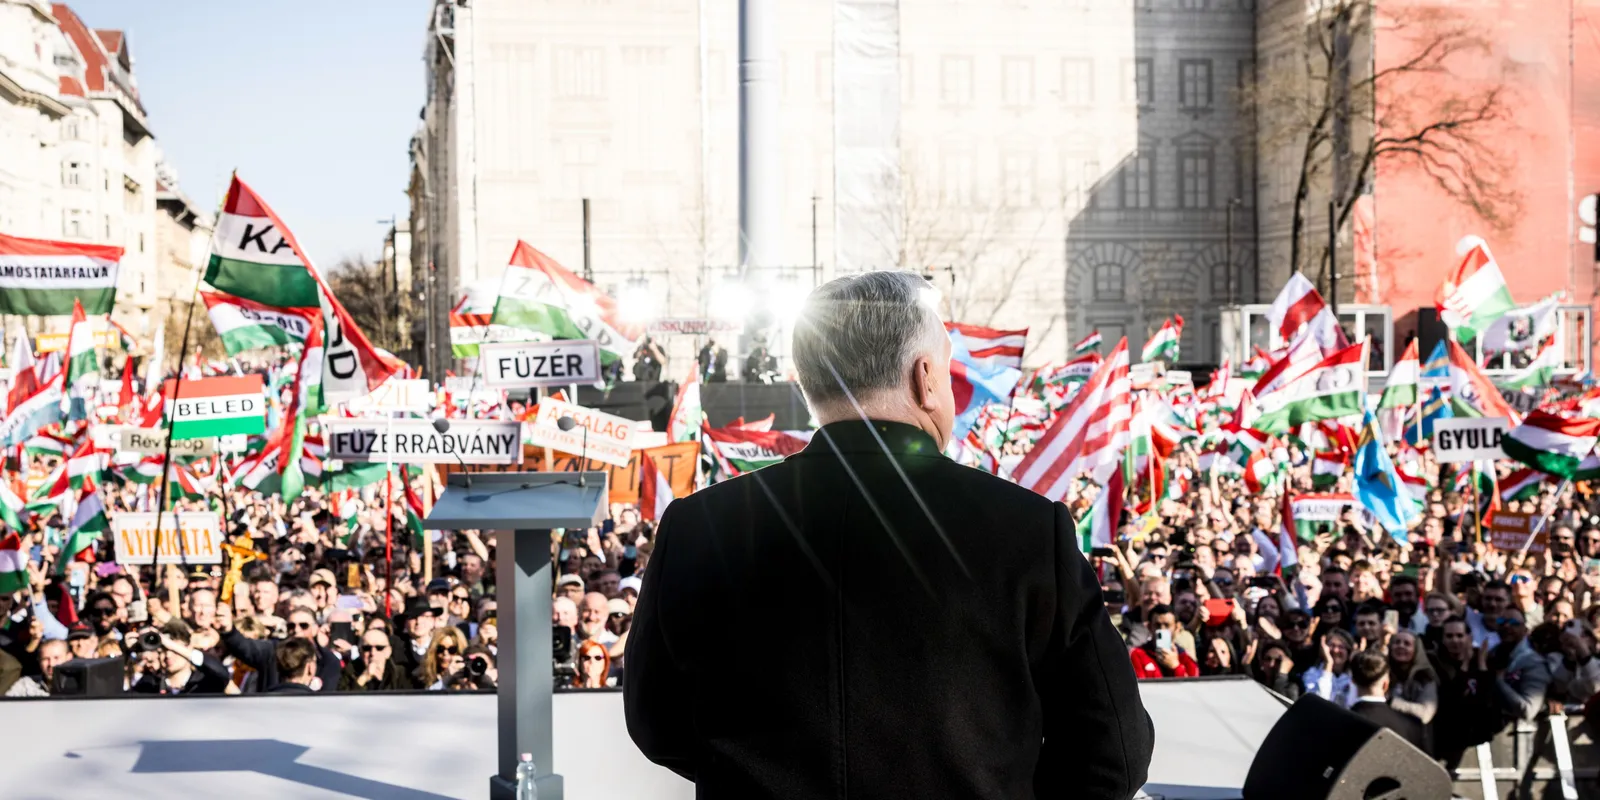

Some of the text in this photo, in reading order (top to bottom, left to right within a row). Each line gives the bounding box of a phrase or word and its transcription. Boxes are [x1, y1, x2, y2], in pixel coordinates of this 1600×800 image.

[498, 348, 584, 379] FÜZÉR
[178, 398, 255, 417] BELED
[336, 427, 516, 455] FÜZÉRRADVÁNY
[1438, 427, 1504, 451] GYULA
[121, 520, 214, 556] NYÍRKÁTA
